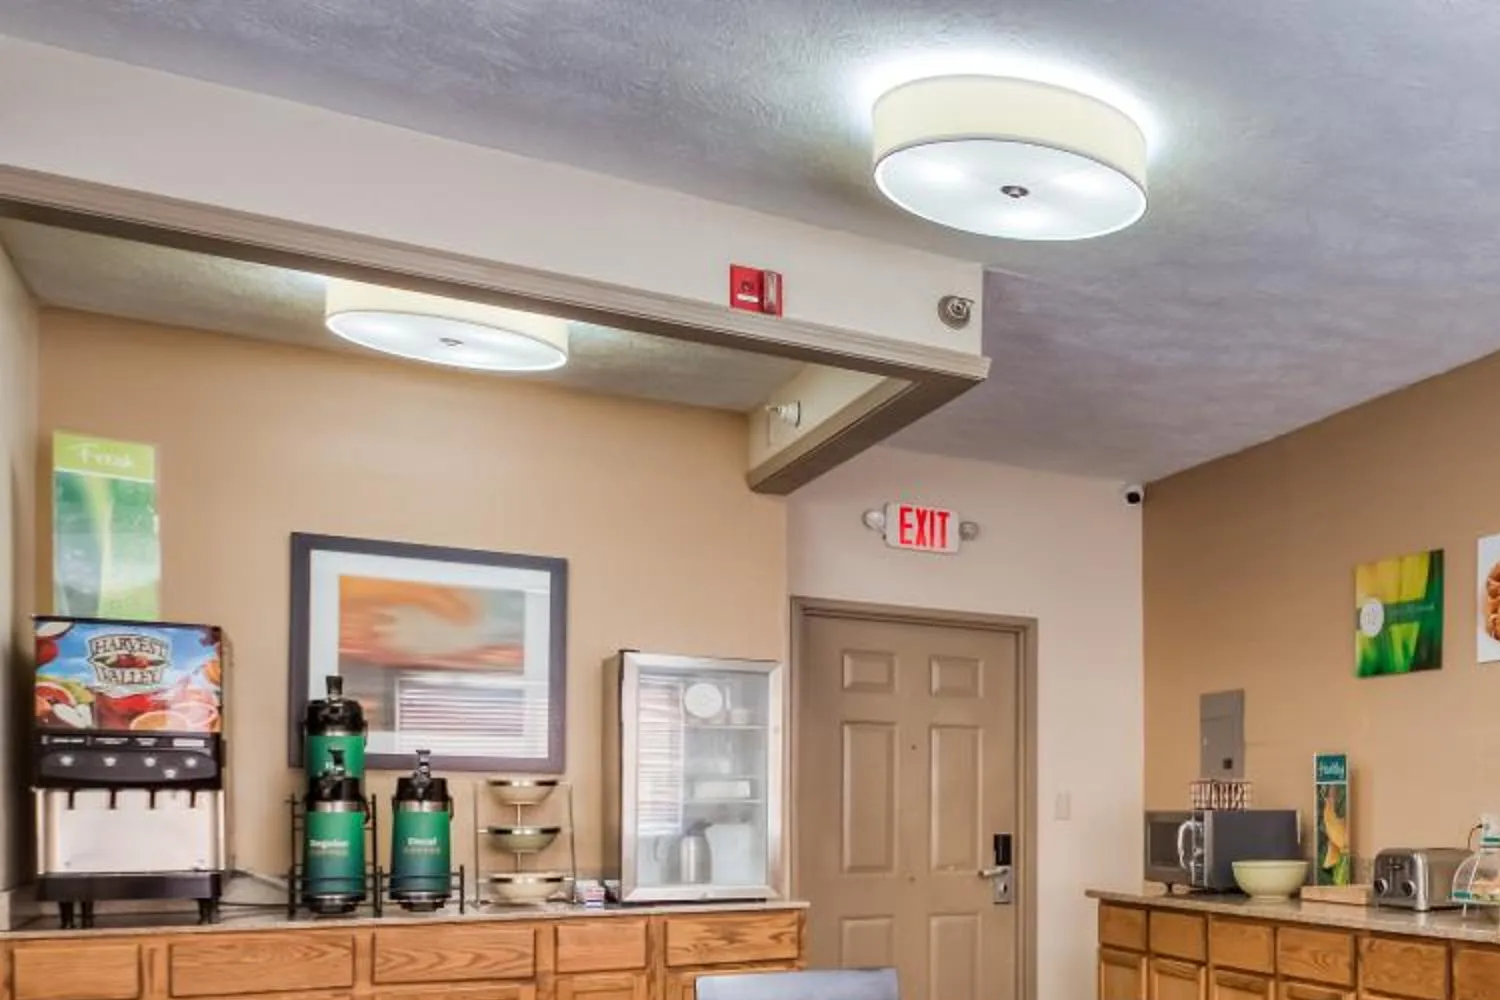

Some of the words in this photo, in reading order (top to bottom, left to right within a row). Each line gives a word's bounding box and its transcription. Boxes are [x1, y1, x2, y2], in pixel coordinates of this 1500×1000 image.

[899, 506, 950, 549] EXIT
[90, 635, 168, 656] HARVEST
[96, 664, 163, 685] VALLEY
